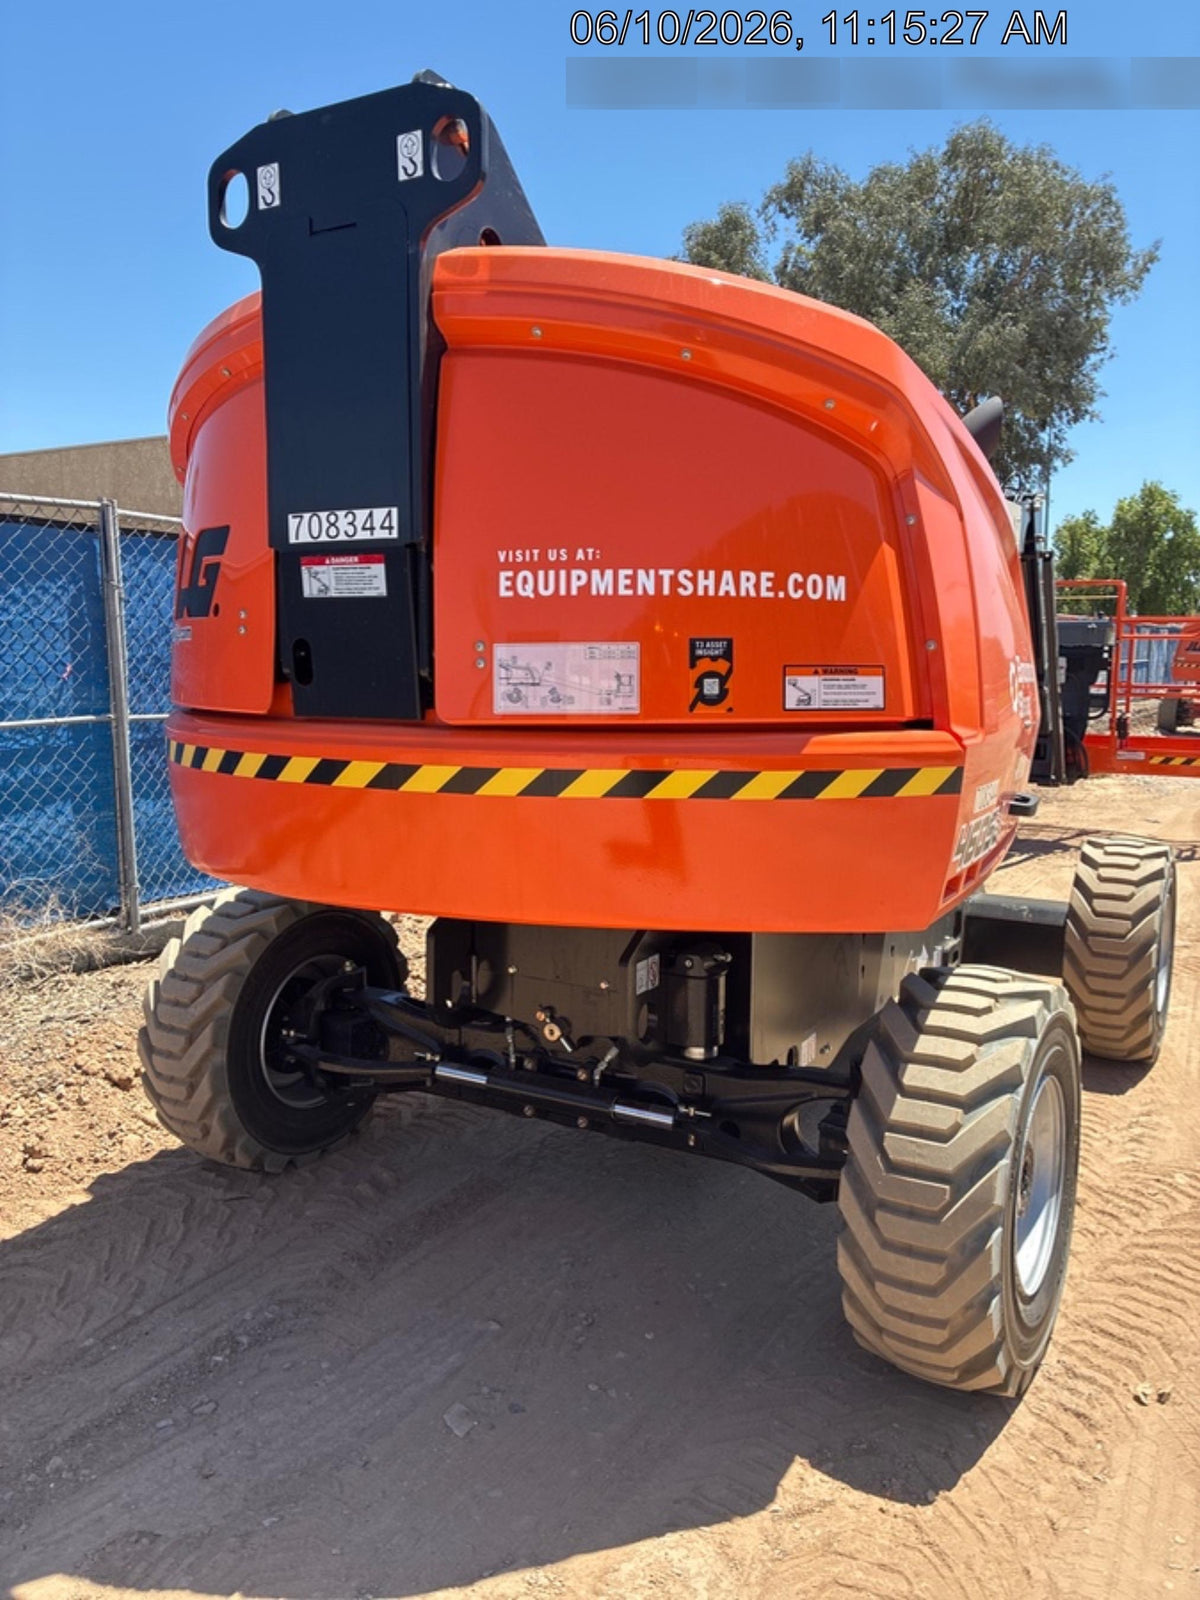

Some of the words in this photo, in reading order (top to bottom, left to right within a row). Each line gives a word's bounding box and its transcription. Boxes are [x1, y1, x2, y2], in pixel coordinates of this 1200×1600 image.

[291, 509, 395, 541] 708344
[497, 549, 540, 563] VISIT
[547, 549, 569, 562] US
[575, 548, 601, 562] AT:
[176, 524, 231, 620] LG
[498, 568, 847, 602] EQUIPMENTSHARE.COM
[705, 641, 728, 649] ASSET
